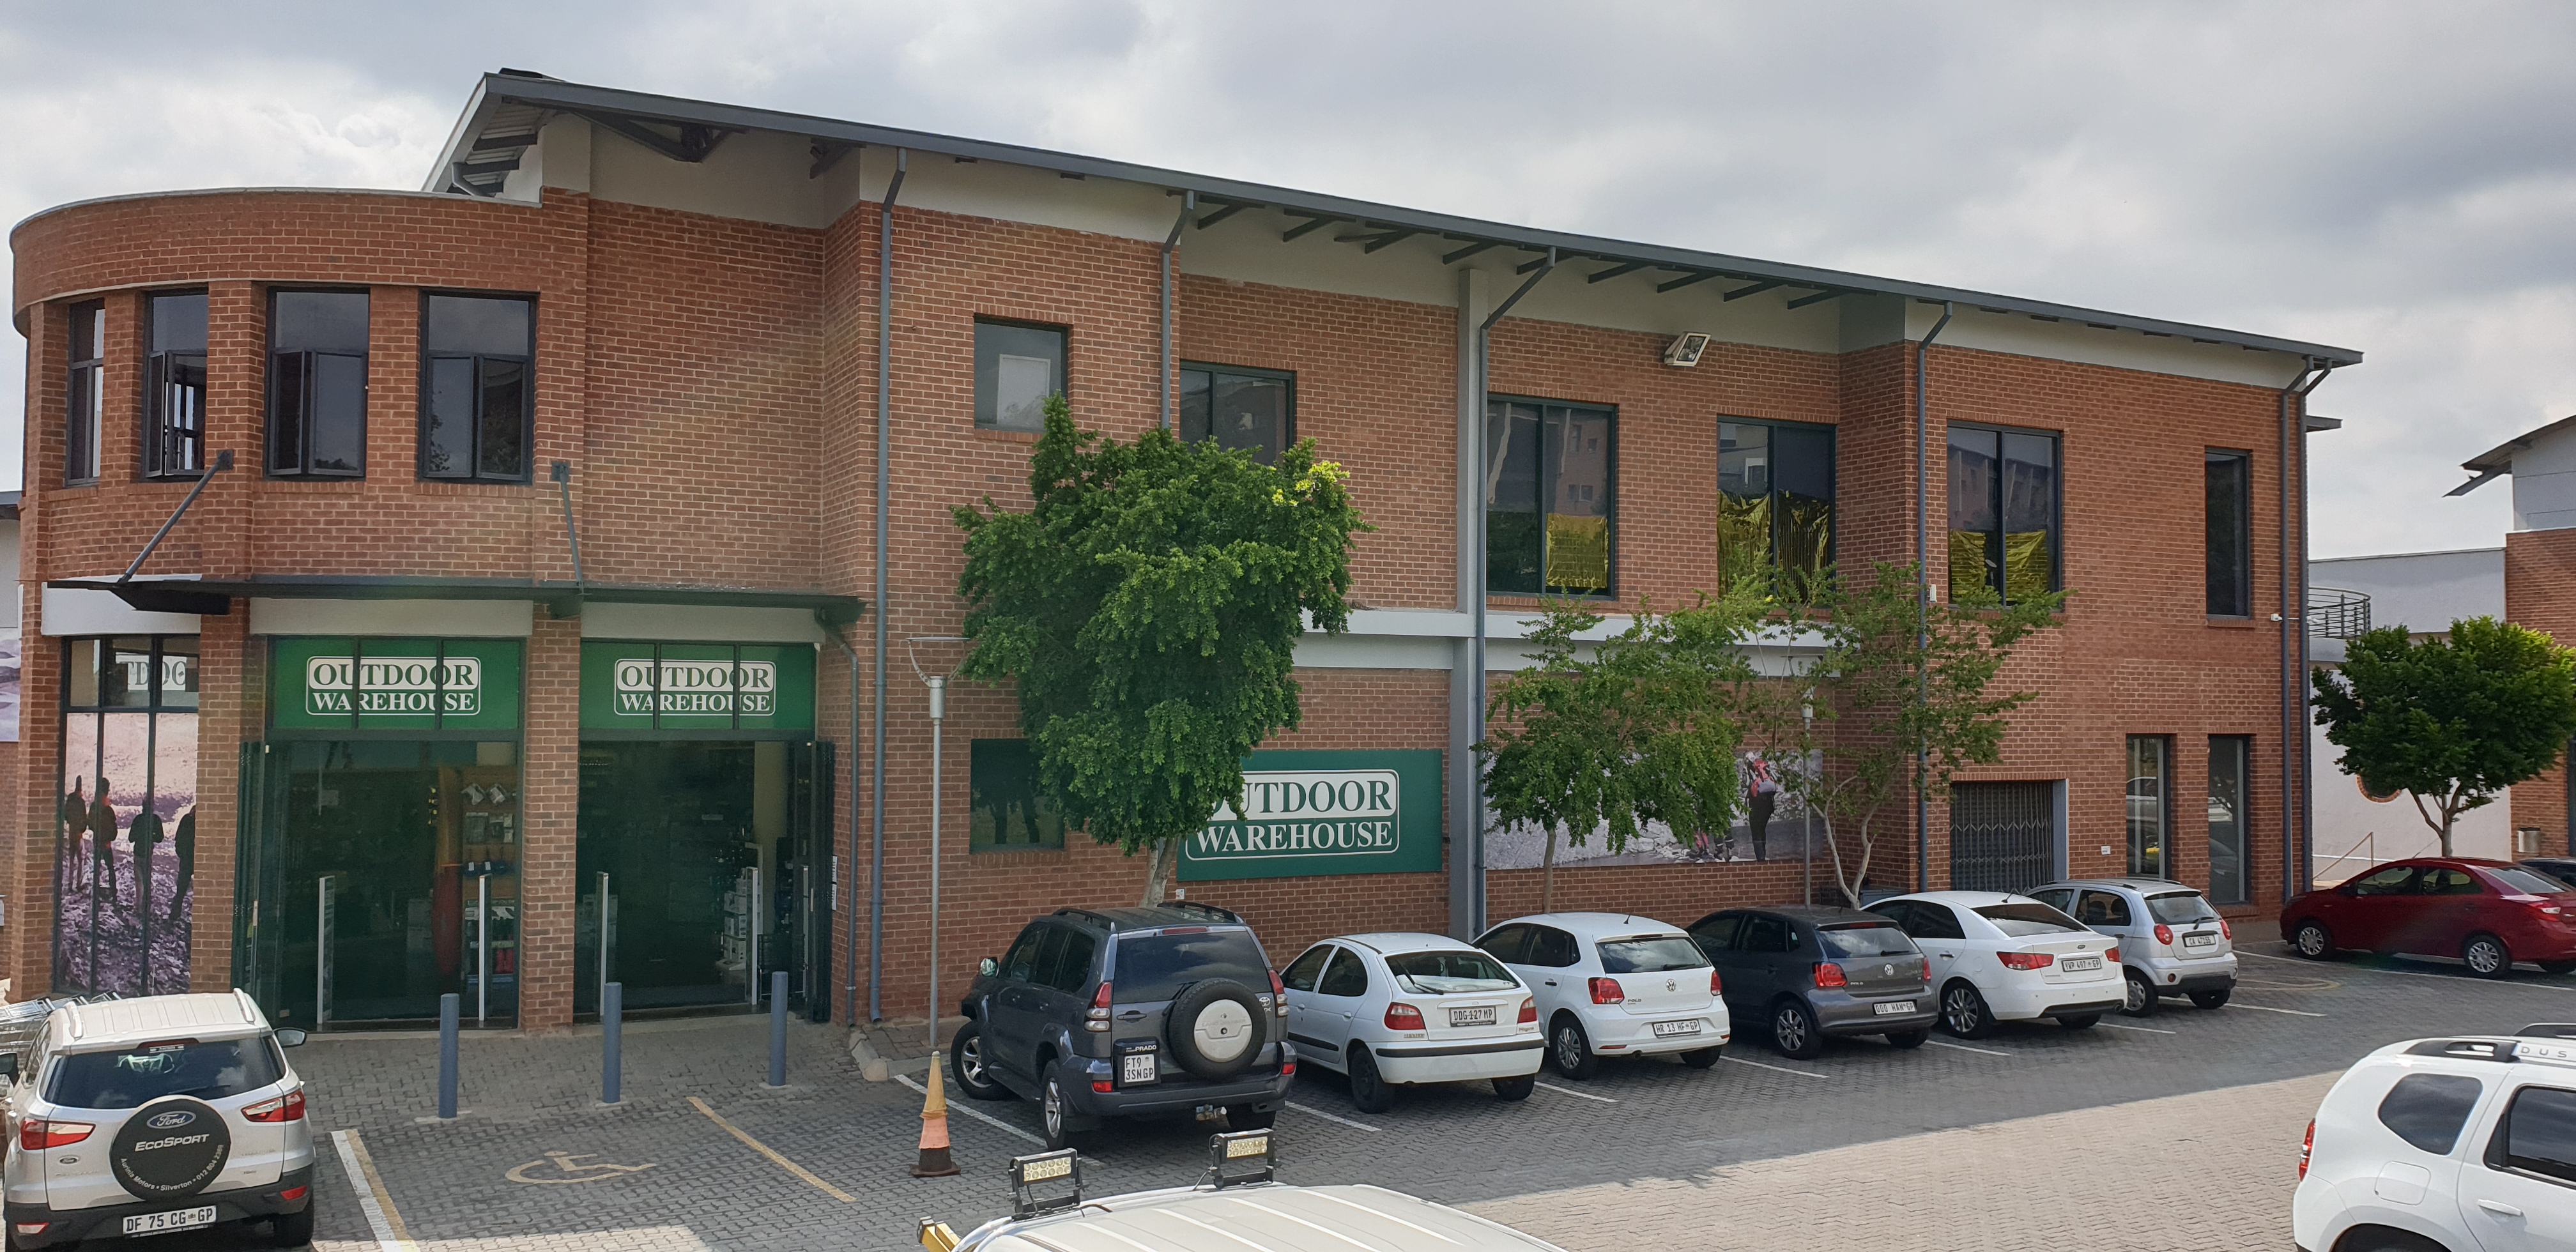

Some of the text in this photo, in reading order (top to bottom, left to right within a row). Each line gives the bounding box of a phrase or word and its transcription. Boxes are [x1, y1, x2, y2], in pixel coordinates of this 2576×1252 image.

[313, 663, 475, 686] OUTDOOR
[621, 666, 770, 688] OUTDOOR
[312, 692, 475, 711] WAREHOUSE
[620, 694, 770, 712] WAREHOUSE
[1197, 821, 1393, 853] WAREHOUSE
[2092, 959, 2099, 968] GP
[1453, 1011, 1468, 1021] DDG
[1483, 1009, 1492, 1019] MP
[1906, 1002, 1913, 1011] GP
[1655, 1021, 1698, 1034] HR 13 HF GP
[157, 1113, 186, 1127] Ford
[133, 1175, 156, 1190] Motors
[160, 1180, 192, 1191] Silverton
[195, 1169, 208, 1180] 012
[126, 1218, 142, 1232] DF
[149, 1214, 164, 1229] 75
[170, 1211, 186, 1225] CG
[197, 1208, 213, 1222] GP
